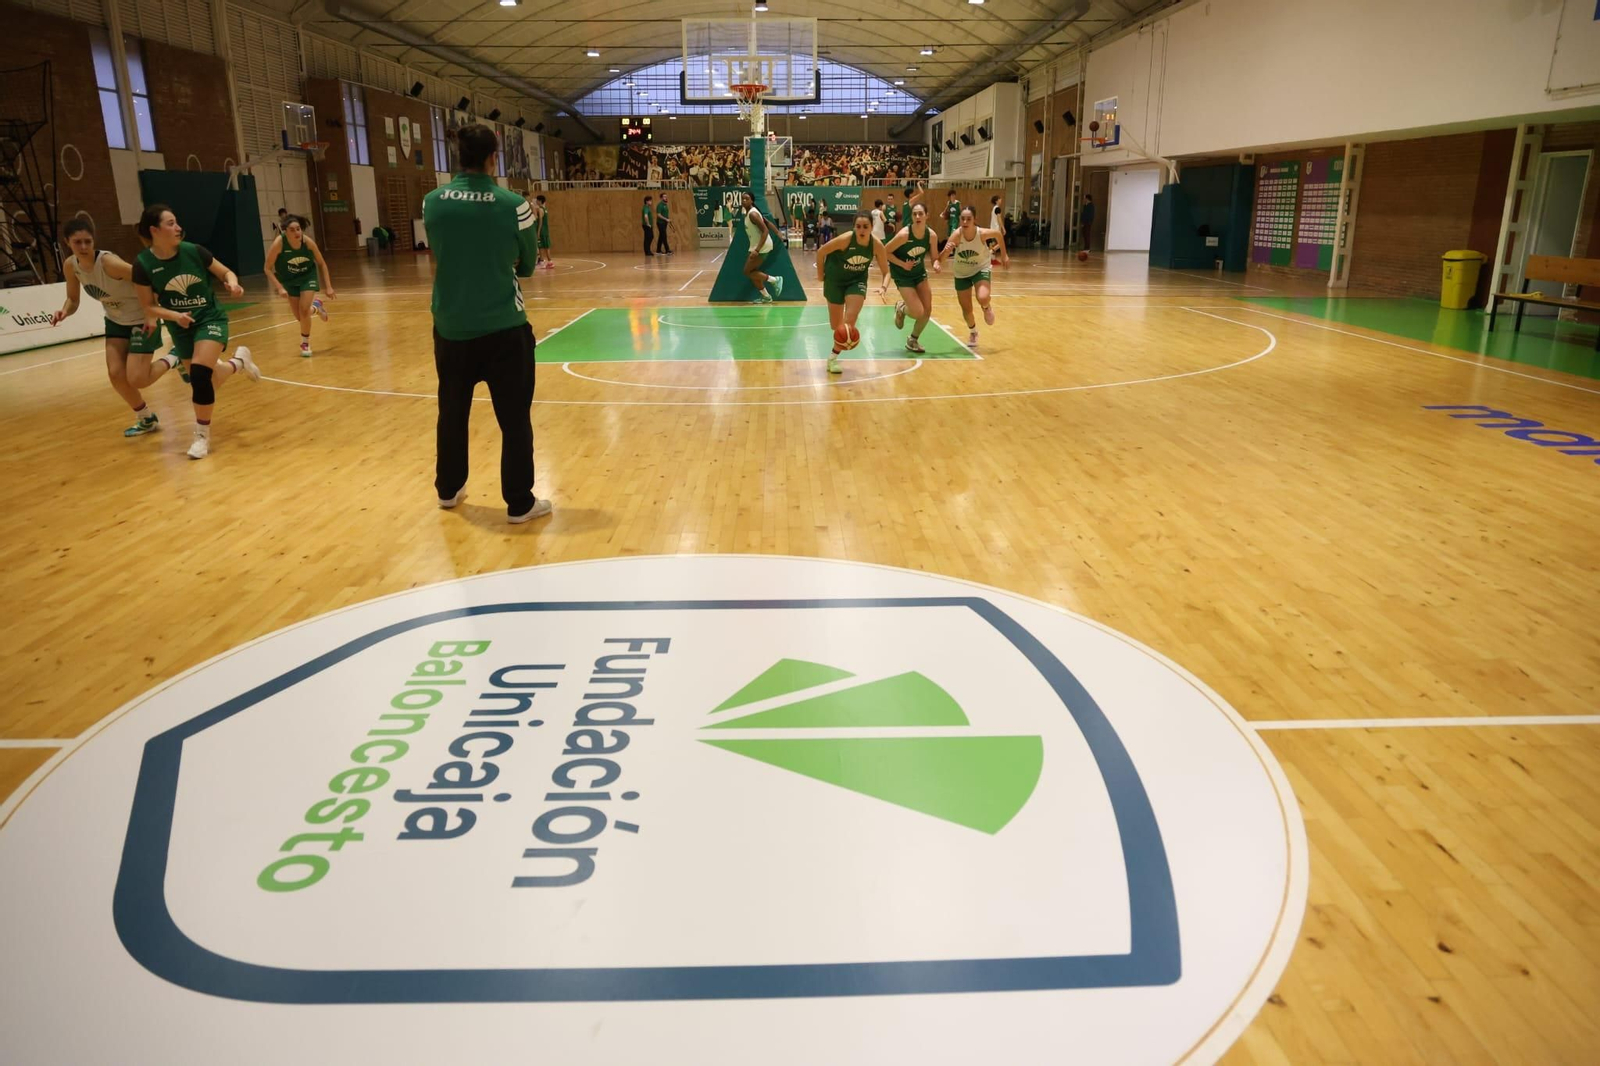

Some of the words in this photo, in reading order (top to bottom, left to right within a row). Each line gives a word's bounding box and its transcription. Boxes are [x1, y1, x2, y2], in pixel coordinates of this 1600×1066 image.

[170, 295, 207, 306] Unicaja
[700, 232, 724, 240] Unicaja
[256, 640, 492, 893] Baloncesto
[393, 664, 566, 840] Unicaja
[511, 637, 672, 888] Fundación
